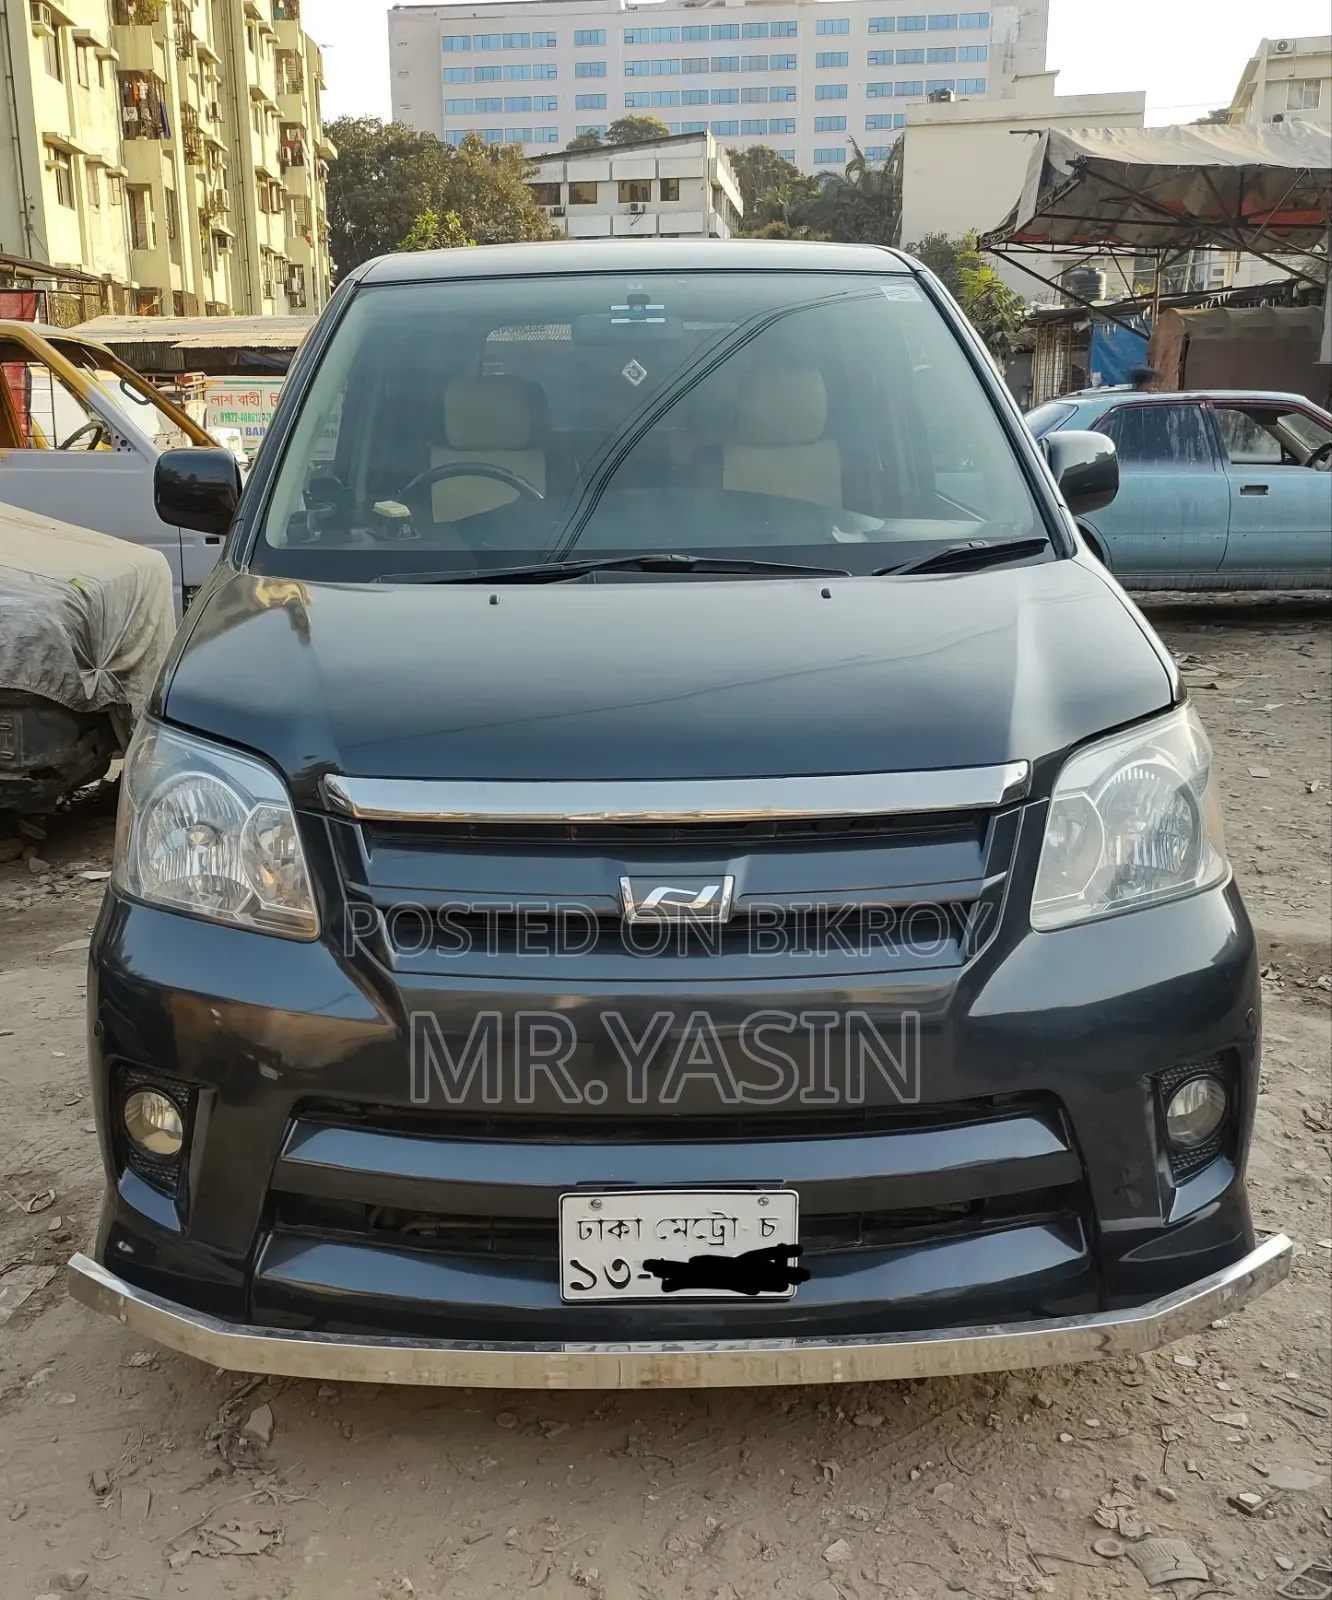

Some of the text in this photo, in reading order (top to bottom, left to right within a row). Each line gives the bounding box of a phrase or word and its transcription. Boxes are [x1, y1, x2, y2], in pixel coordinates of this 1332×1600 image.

[210, 394, 233, 406] লাশ
[237, 392, 261, 407] বাহী
[576, 1210, 781, 1247] ঢাকা মেট্রো চ
